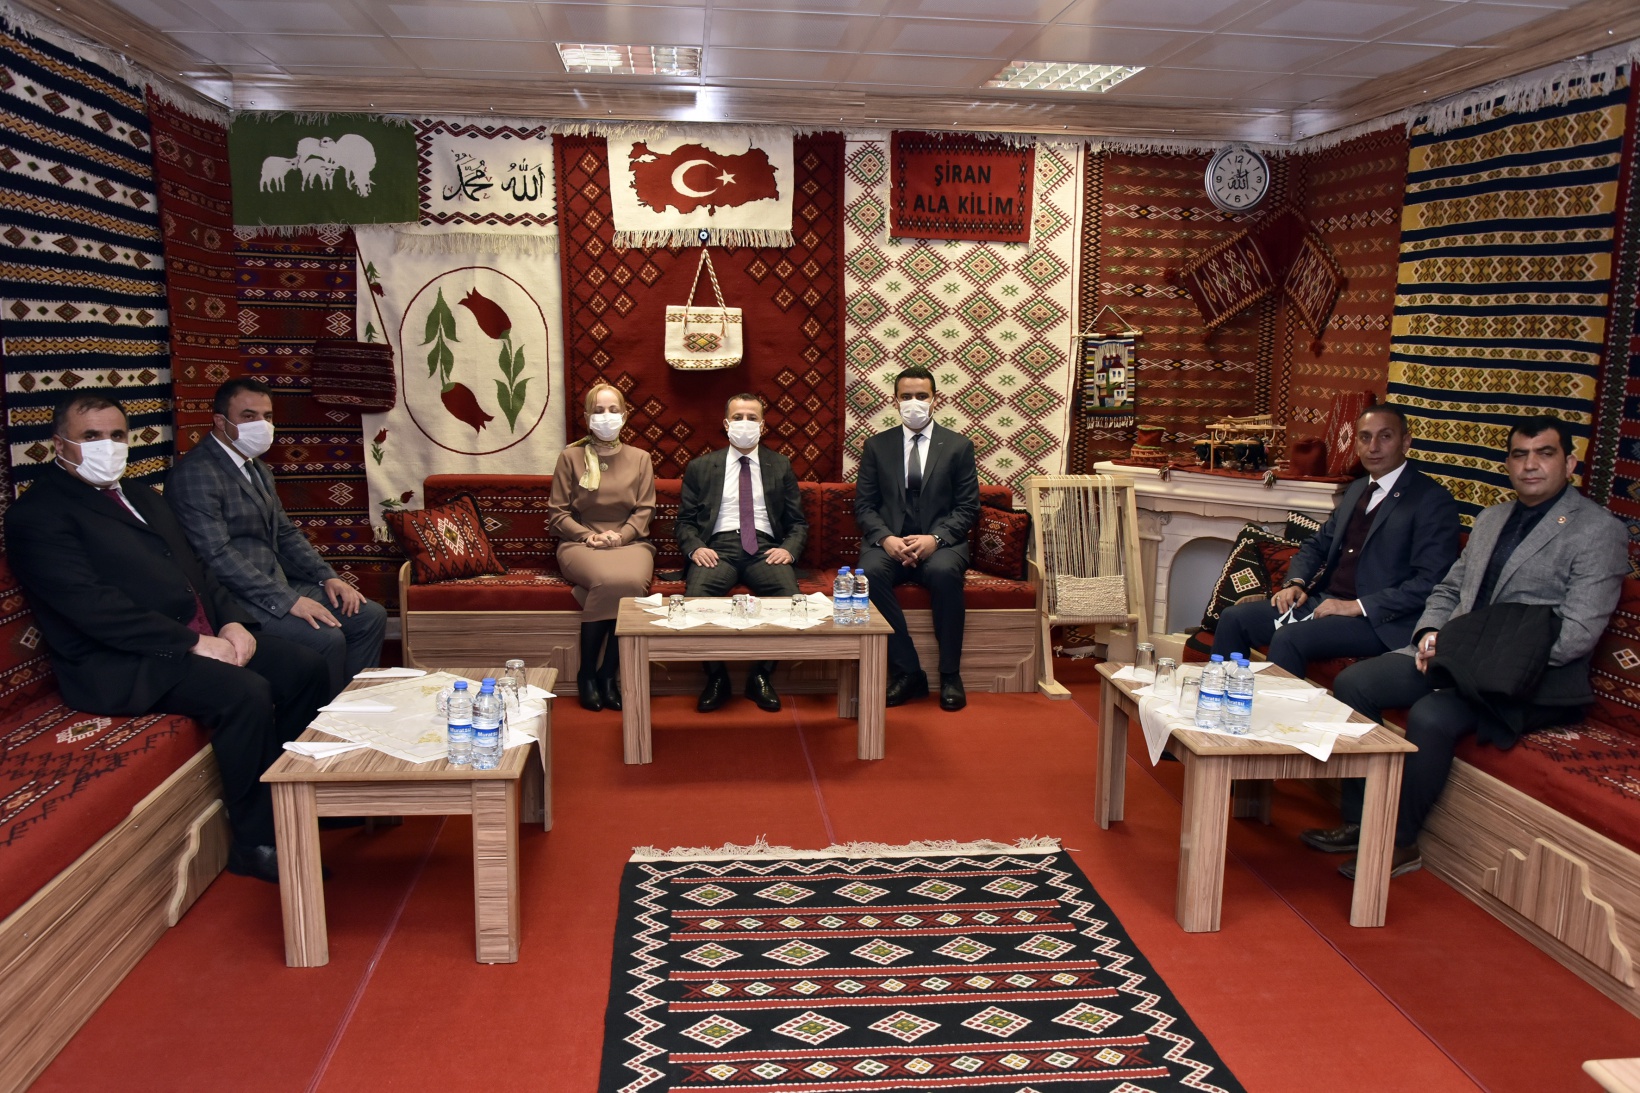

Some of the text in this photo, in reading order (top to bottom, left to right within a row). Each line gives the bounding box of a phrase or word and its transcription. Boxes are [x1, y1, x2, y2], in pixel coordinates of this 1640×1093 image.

[1234, 155, 1244, 163] 12
[934, 160, 991, 186] ŞİRAN
[1215, 175, 1222, 183] 9
[1255, 175, 1262, 183] 3
[1234, 195, 1241, 203] 6
[913, 192, 1013, 215] ALA KİLİM
